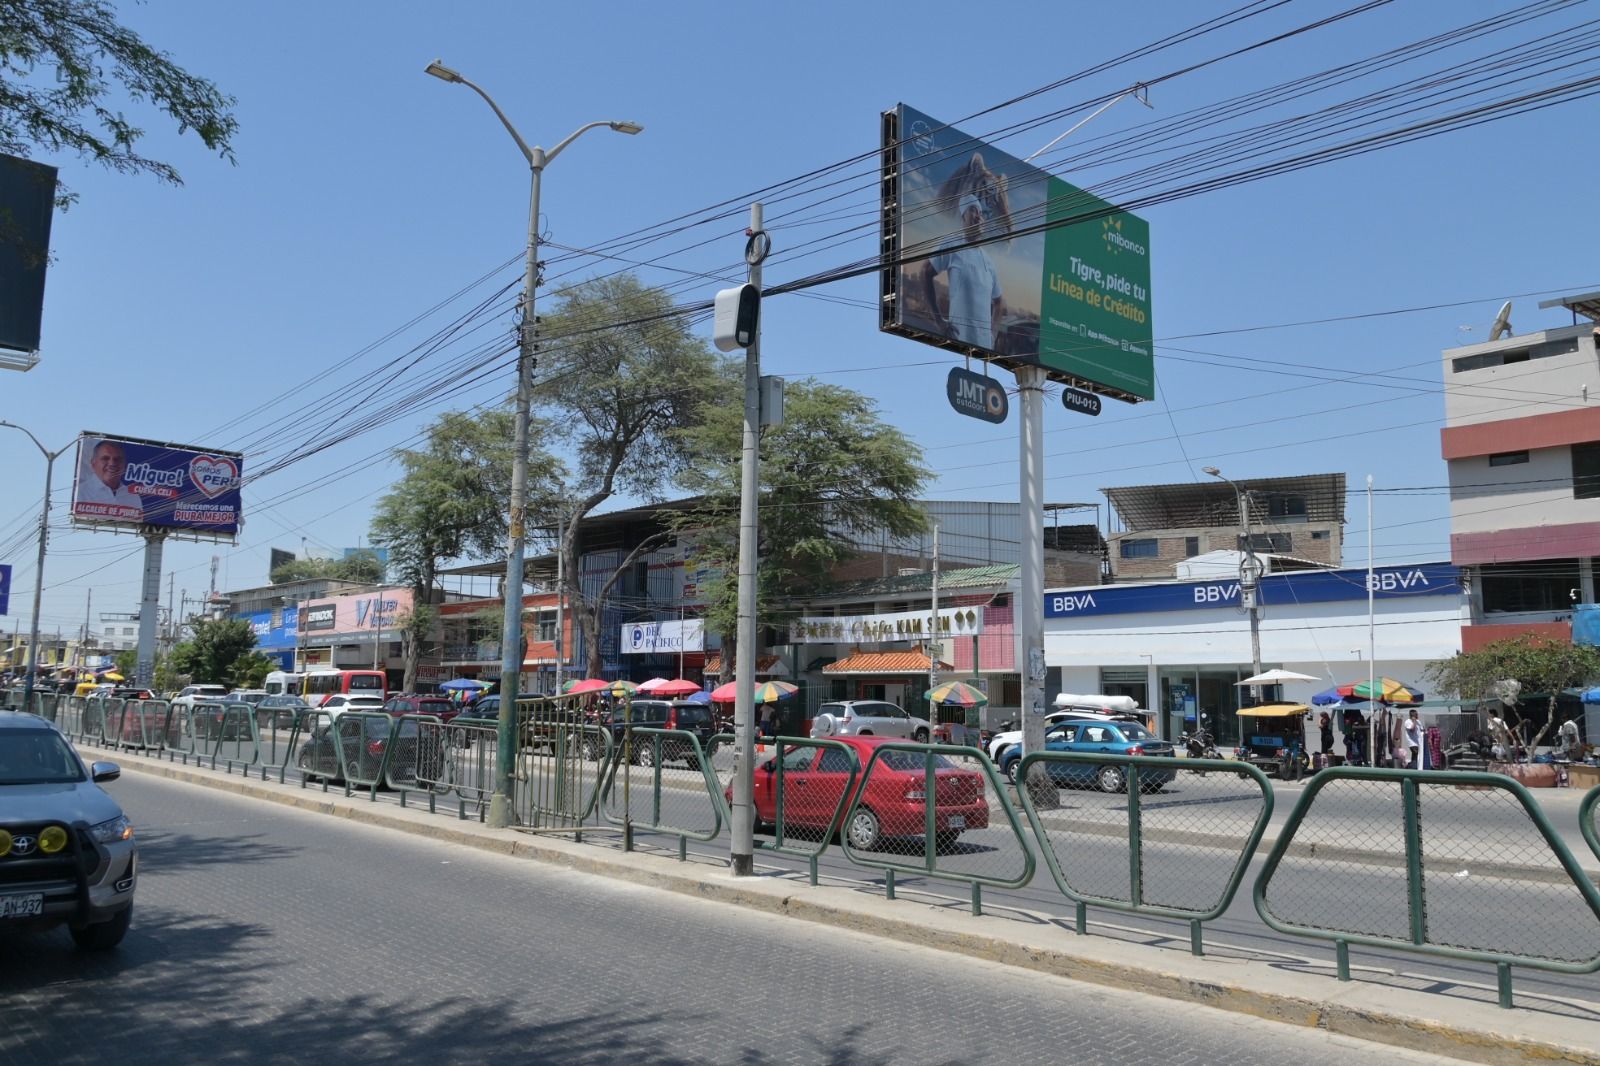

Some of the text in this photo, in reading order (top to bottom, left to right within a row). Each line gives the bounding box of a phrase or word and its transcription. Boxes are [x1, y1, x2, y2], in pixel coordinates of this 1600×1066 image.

[1108, 232, 1145, 256] mibanco
[1070, 256, 1146, 302] Tigre, pide tu
[1049, 273, 1145, 323] Línea de Crédito
[956, 378, 985, 404] JMT
[956, 399, 986, 413] outdoors
[1066, 392, 1098, 411] PIU-012
[125, 463, 185, 487] Miguel
[192, 465, 221, 475] SOMOS
[133, 485, 156, 496] CUEVA
[76, 504, 107, 515] ALCALDE
[108, 506, 118, 516] DE
[176, 502, 234, 512] Merecemos una
[174, 511, 235, 523] PIURA MEJOR
[1365, 569, 1429, 592] BBVA
[1194, 582, 1242, 603] BBVA
[1053, 593, 1096, 612] BBVA
[646, 626, 661, 637] DEL
[897, 618, 922, 634] KAM
